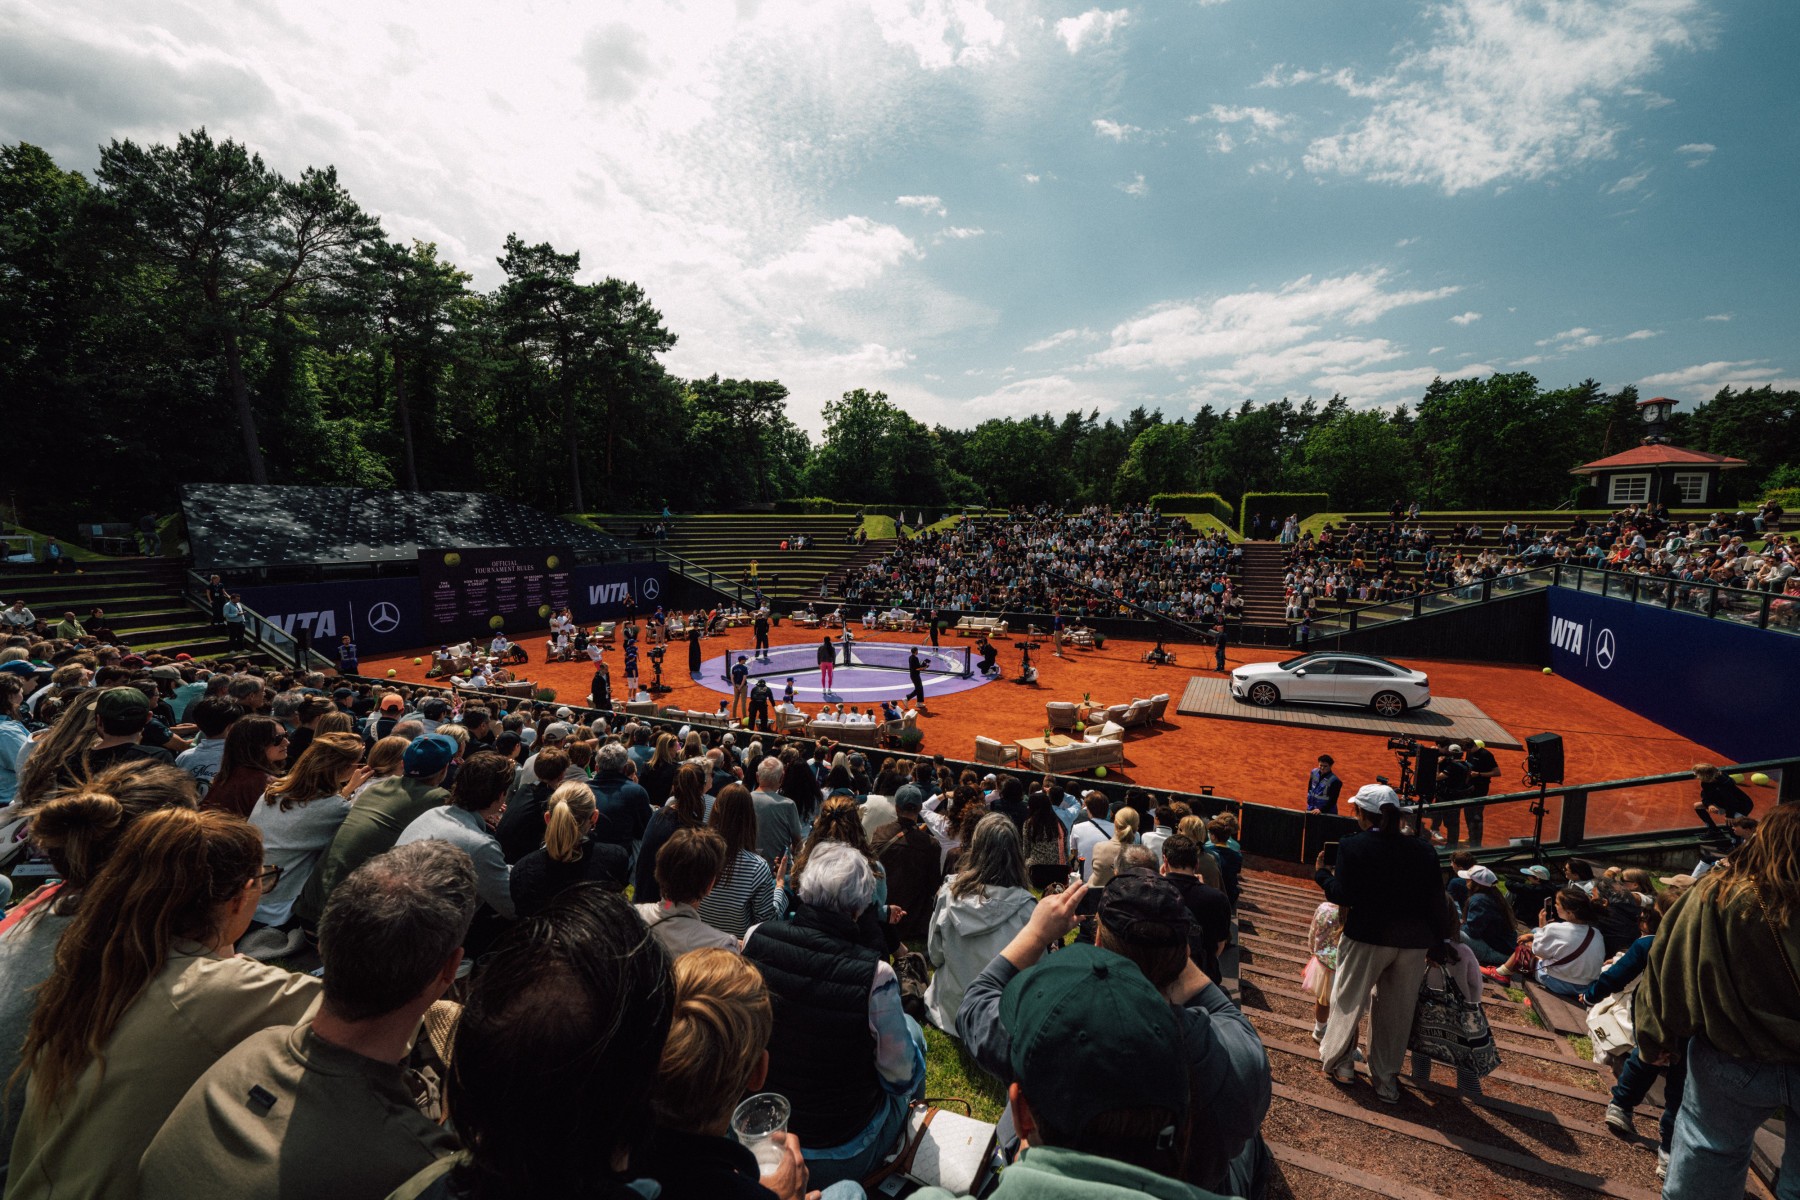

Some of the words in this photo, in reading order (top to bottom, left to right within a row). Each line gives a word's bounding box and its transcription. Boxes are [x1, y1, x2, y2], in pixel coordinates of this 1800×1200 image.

[475, 565, 516, 574] TOURNAMENT
[516, 564, 534, 572] RULES
[588, 582, 629, 606] WTA
[1550, 615, 1583, 655] WTA
